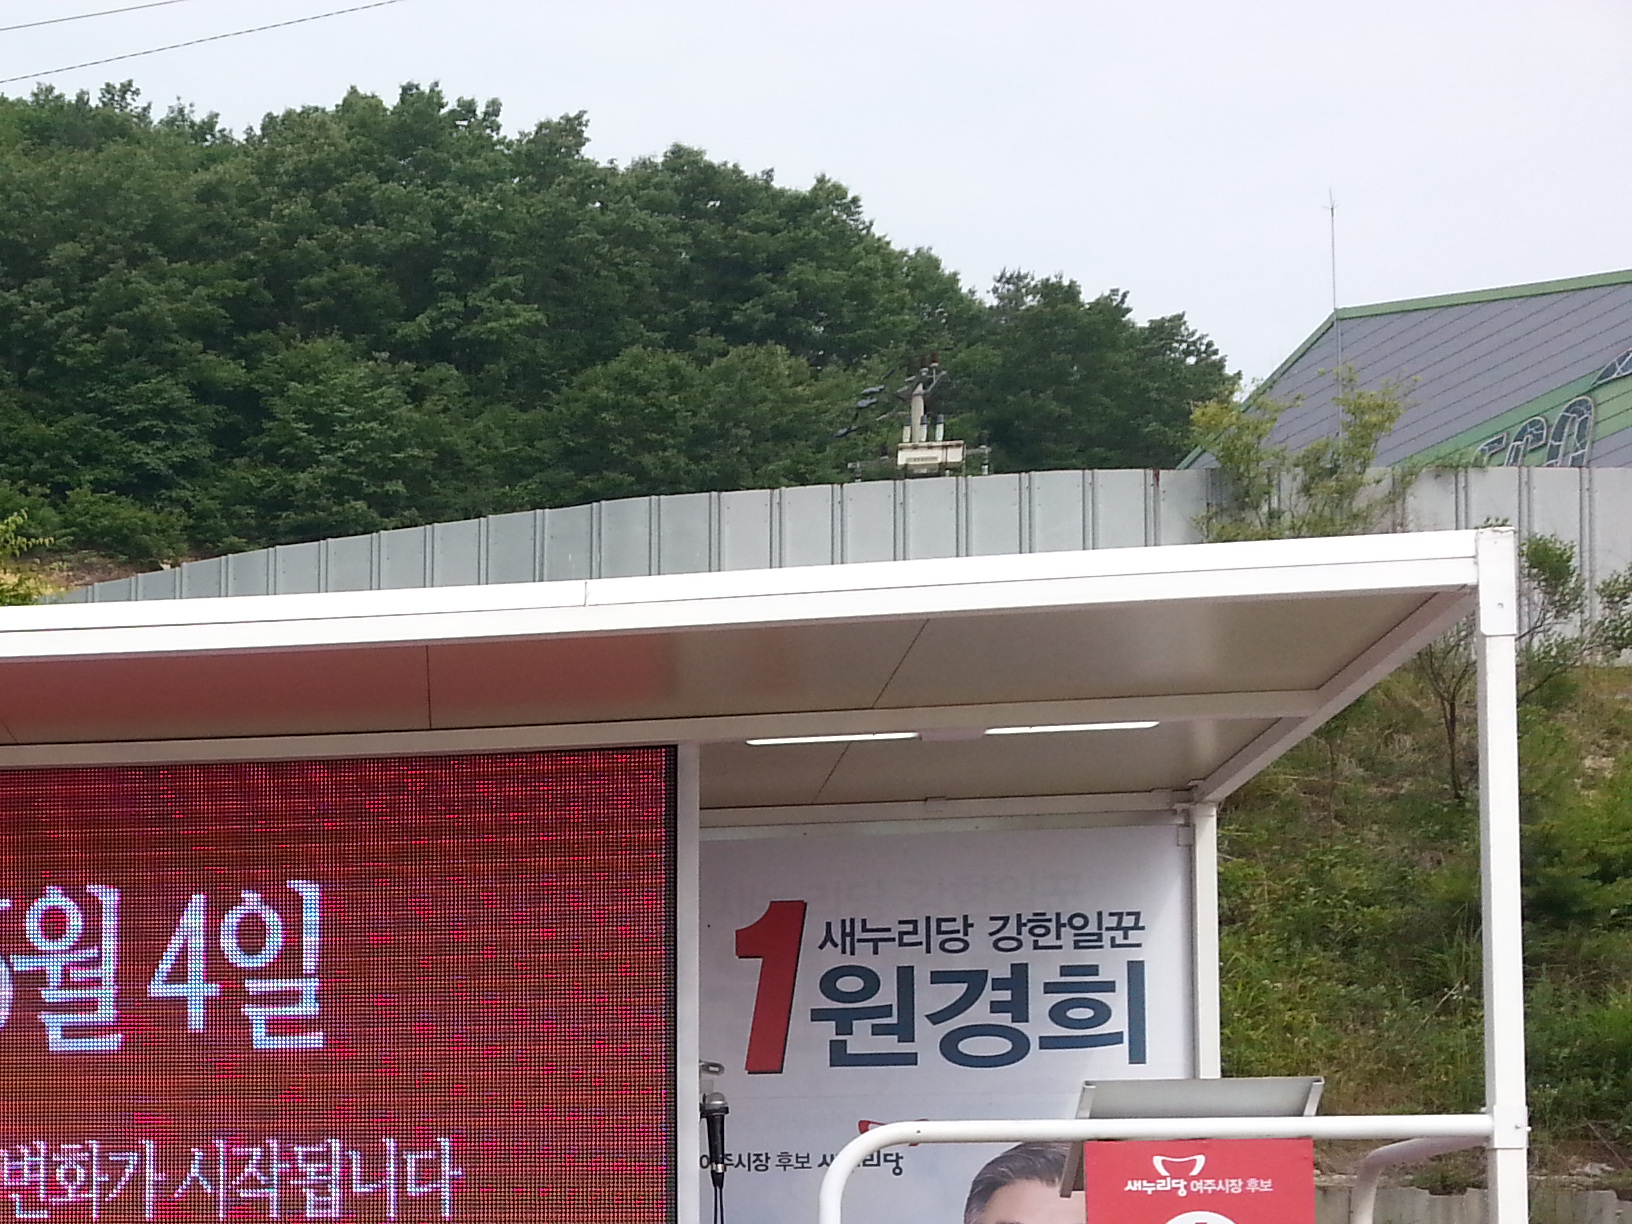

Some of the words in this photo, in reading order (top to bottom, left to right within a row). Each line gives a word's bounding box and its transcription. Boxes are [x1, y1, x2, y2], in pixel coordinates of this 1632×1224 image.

[147, 879, 325, 1049] 4일
[818, 914, 974, 956] 새누리당
[988, 910, 1145, 952] 강한일꾼
[735, 900, 807, 1074] 1
[810, 959, 1147, 1068] 원경희
[174, 1138, 464, 1221] 시작됩니다
[775, 1151, 812, 1171] 후보
[1124, 1177, 1187, 1197] 새누리당
[1190, 1179, 1243, 1194] 여주시장
[1246, 1178, 1273, 1193] 후보
